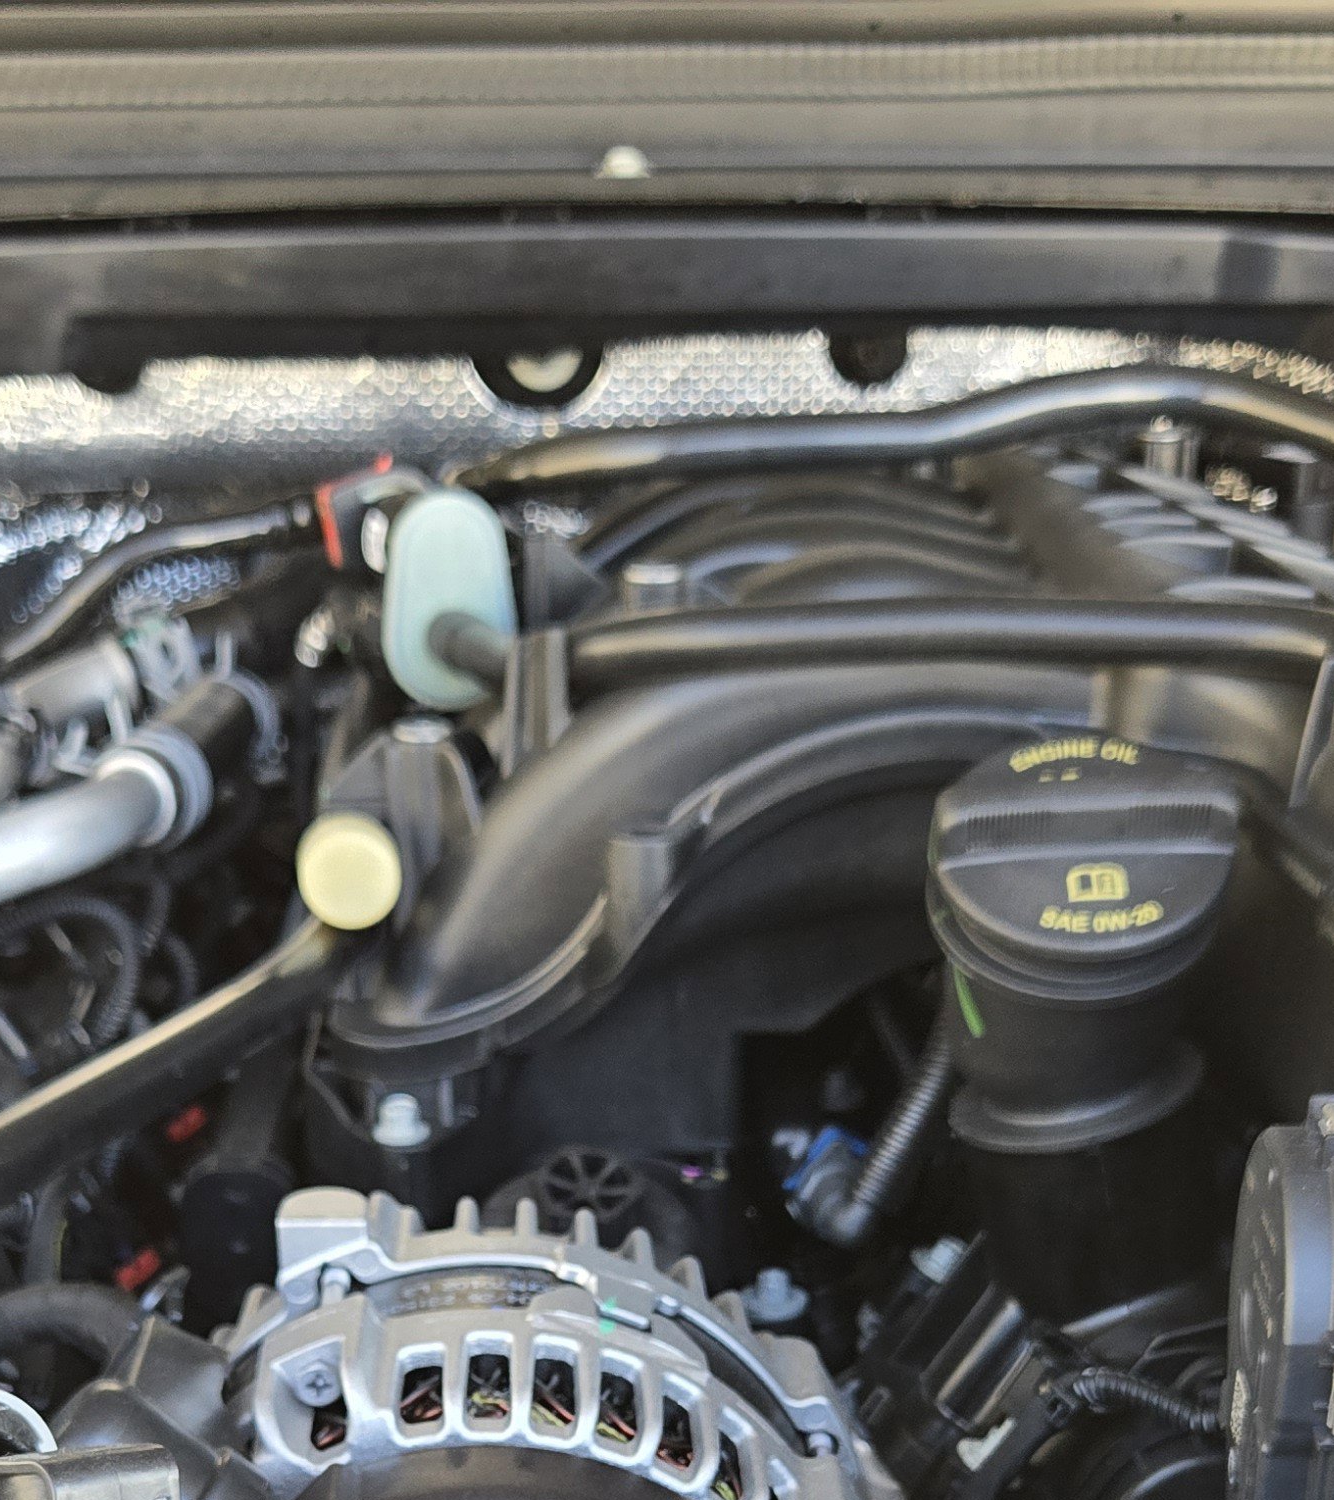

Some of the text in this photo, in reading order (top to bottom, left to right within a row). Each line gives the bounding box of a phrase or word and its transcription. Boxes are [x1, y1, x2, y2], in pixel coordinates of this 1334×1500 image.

[1009, 737, 1140, 772] ENGINE OIL
[1039, 904, 1091, 933] SAE
